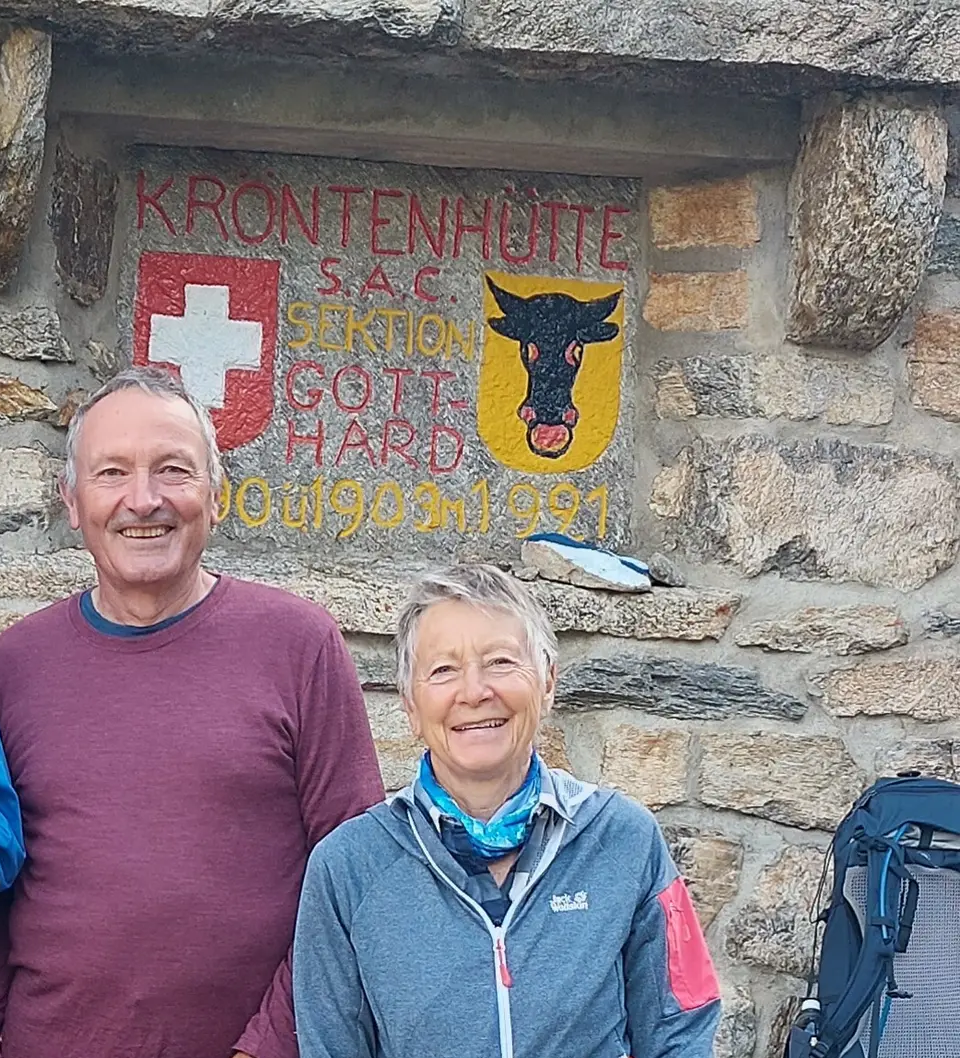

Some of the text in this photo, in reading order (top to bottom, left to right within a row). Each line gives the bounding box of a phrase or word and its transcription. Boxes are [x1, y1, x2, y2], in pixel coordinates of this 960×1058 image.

[136, 168, 630, 272] KRÖNTENHÜTTE
[316, 257, 456, 303] S.A.C.
[287, 302, 475, 357] SEKTION
[286, 360, 469, 417] GOTT-
[286, 417, 464, 474] HARD
